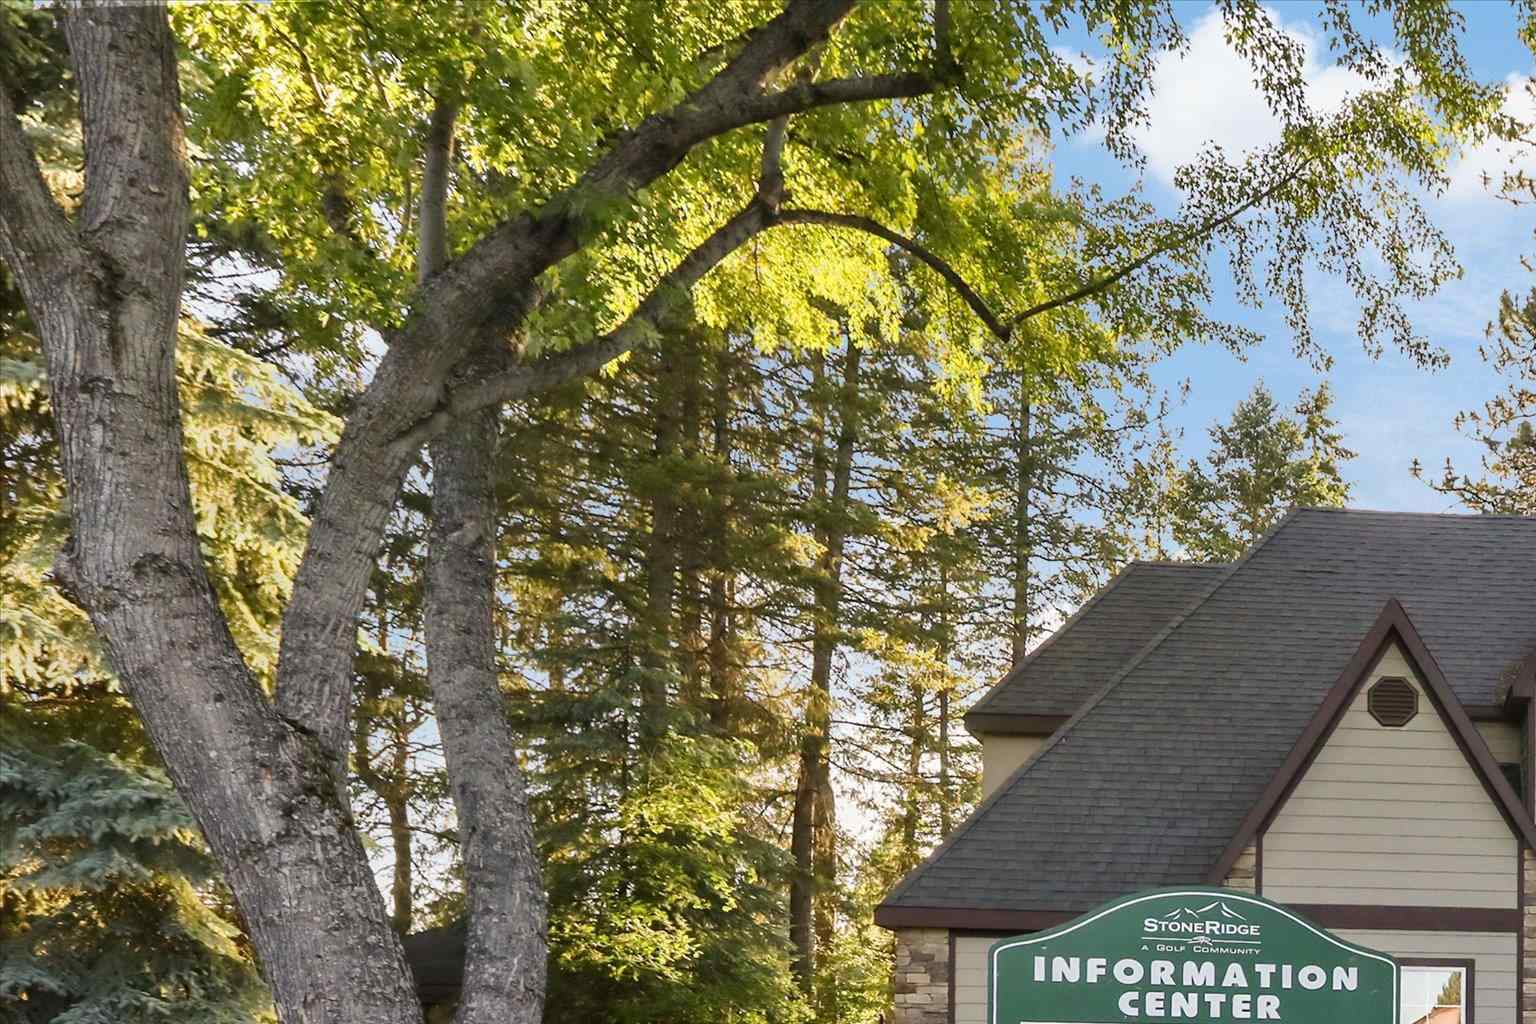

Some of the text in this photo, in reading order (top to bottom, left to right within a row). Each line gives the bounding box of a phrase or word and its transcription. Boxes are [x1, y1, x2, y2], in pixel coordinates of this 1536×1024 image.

[1143, 918, 1260, 935] STONERIDGE
[1156, 944, 1185, 952] GOLF
[1193, 945, 1261, 955] COMMUNITY
[1034, 956, 1358, 991] INFORMATION
[1118, 991, 1281, 1019] CENTER
